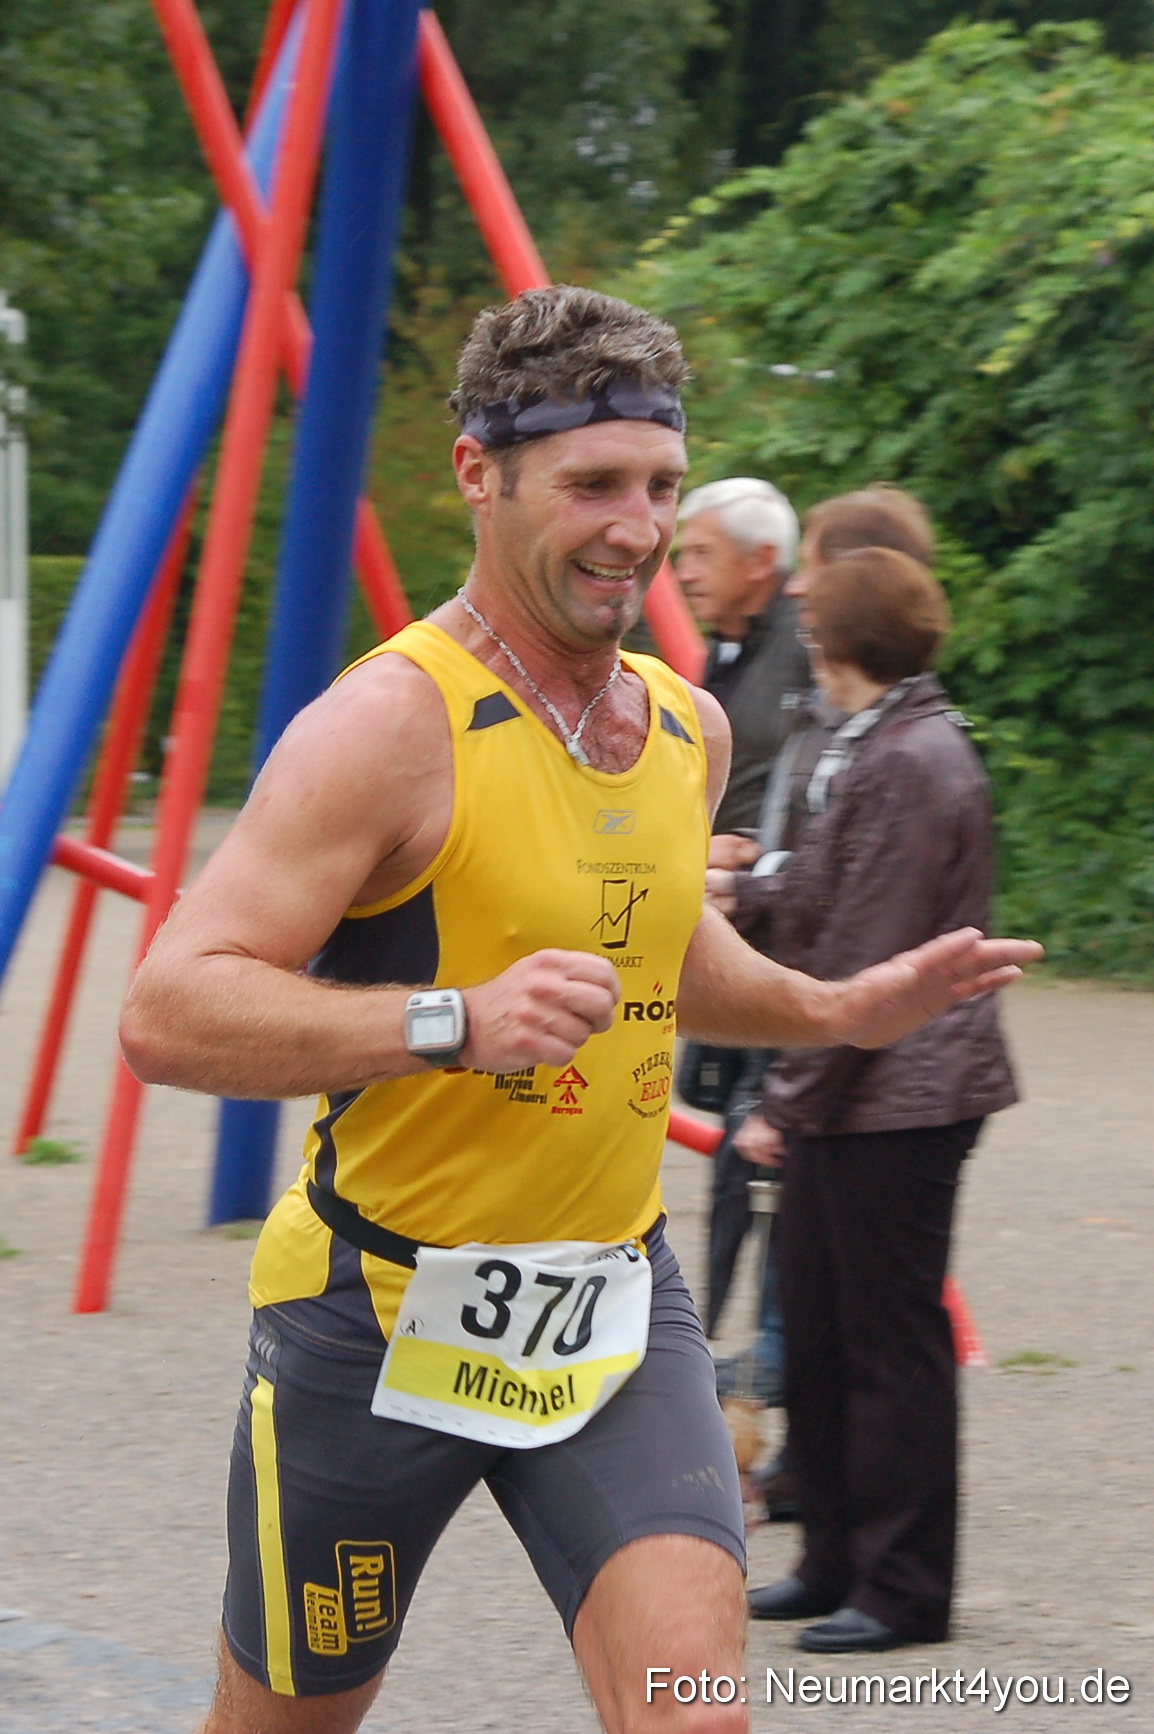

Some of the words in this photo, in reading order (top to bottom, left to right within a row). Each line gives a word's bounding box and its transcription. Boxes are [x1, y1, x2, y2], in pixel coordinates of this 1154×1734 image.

[576, 859, 657, 874] FONDSZENTRUM
[603, 955, 644, 968] MARKT
[460, 1259, 607, 1356] 370
[318, 1592, 339, 1650] Team
[350, 1553, 388, 1631] Run!
